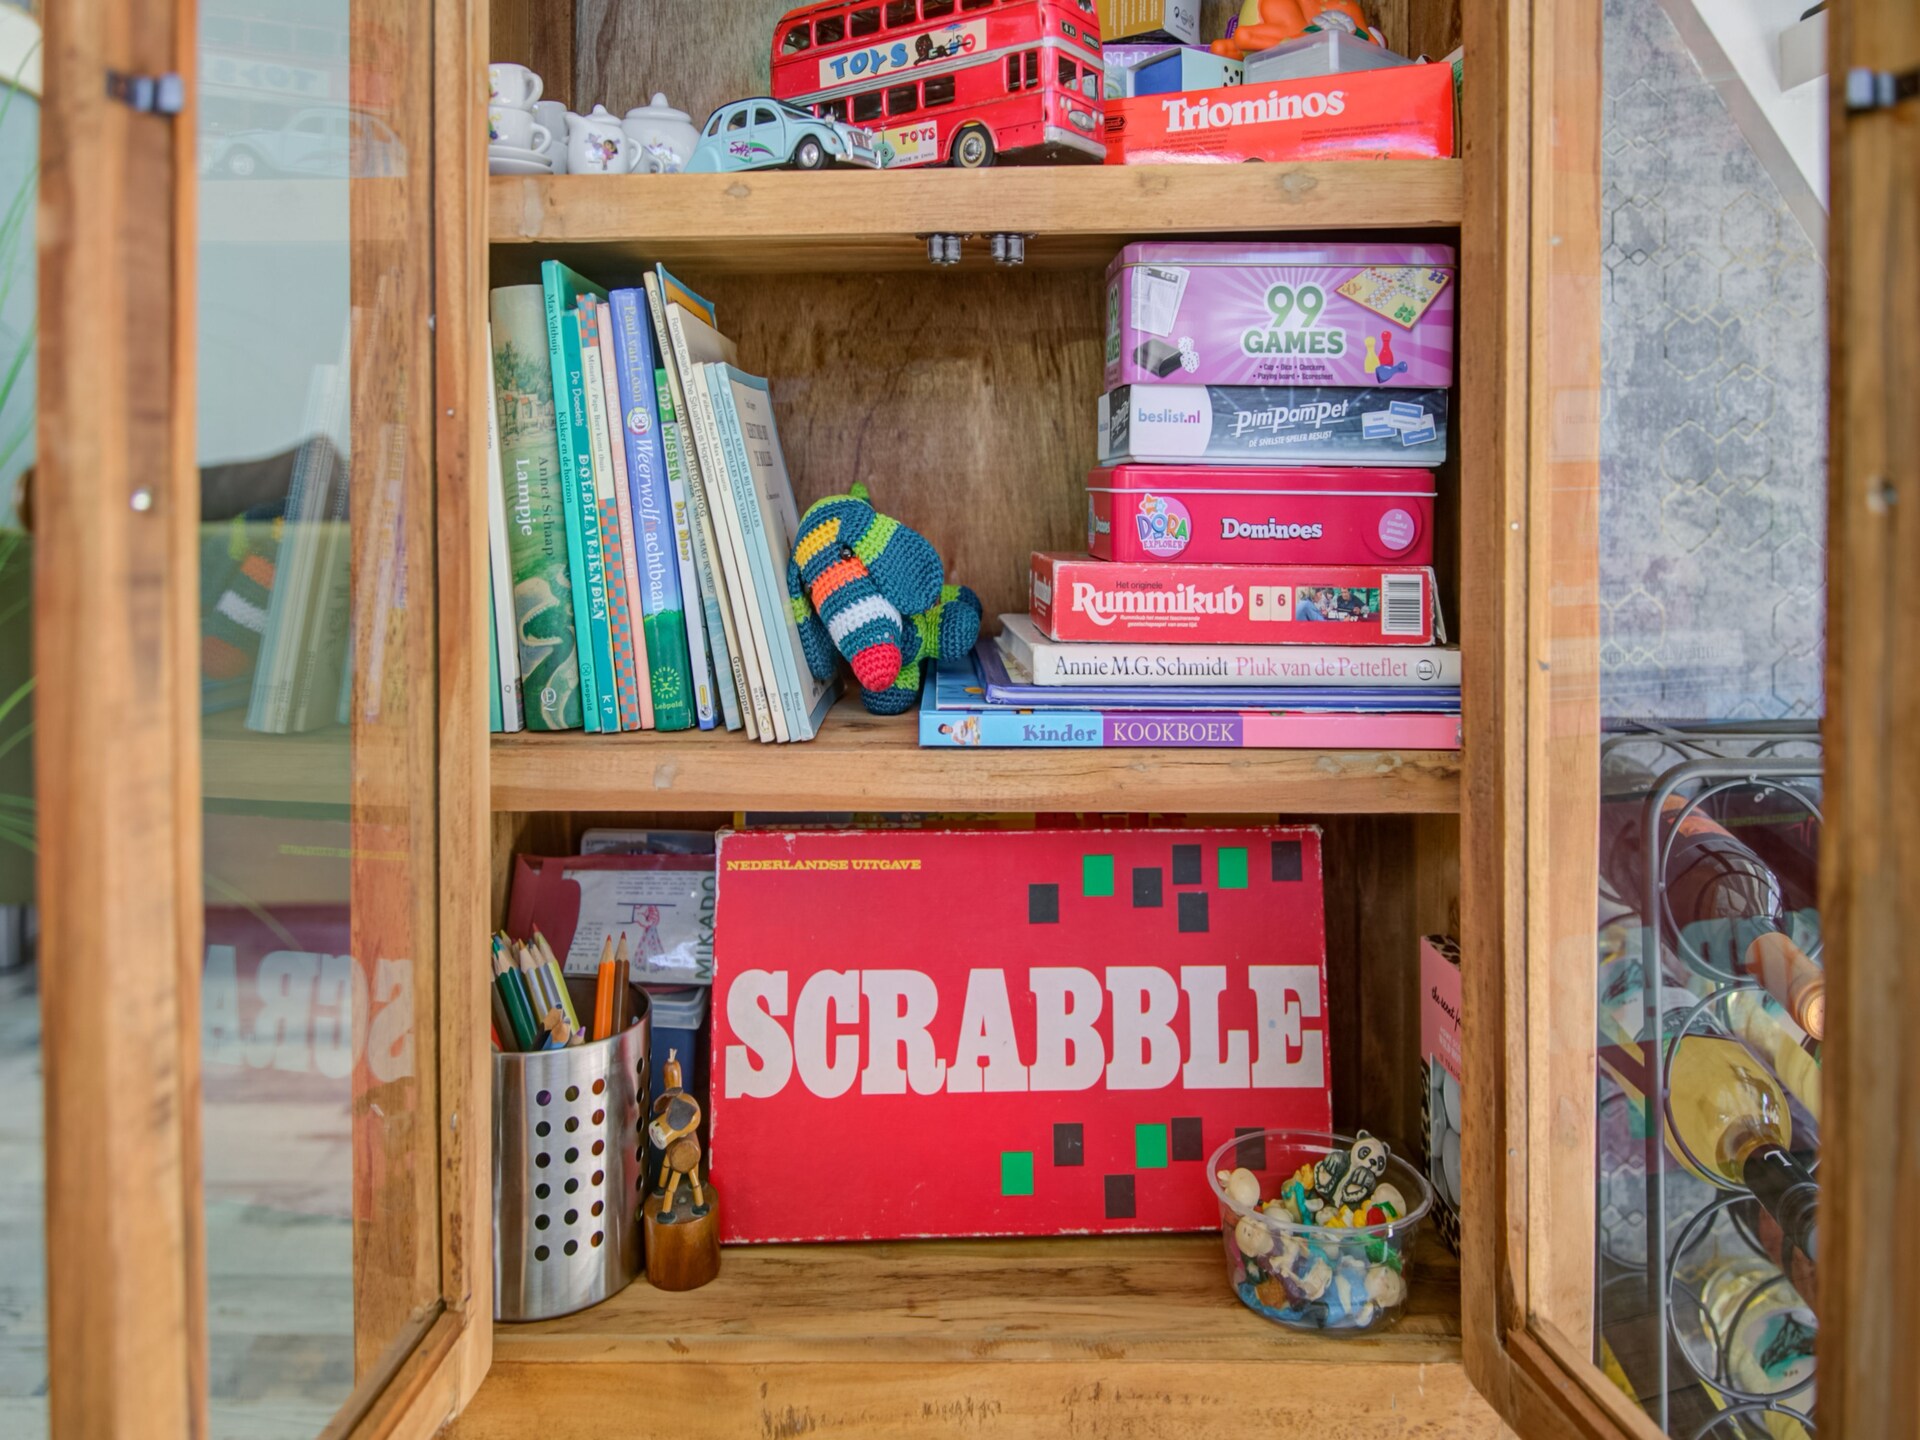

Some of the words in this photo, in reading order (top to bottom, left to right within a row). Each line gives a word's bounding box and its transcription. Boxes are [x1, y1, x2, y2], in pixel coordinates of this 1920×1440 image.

[829, 43, 908, 79] TOYS
[1162, 90, 1345, 132] Triominos
[899, 127, 935, 144] TOYS
[547, 295, 555, 313] Max
[1267, 285, 1323, 328] 99
[624, 306, 639, 335] Paul
[671, 317, 684, 348] Ronald
[549, 317, 559, 354] Velthuijs
[1244, 330, 1343, 354] GAMES
[629, 340, 641, 363] van
[676, 350, 690, 376] Searle
[571, 371, 580, 385] De
[588, 355, 597, 384] Minarik
[631, 366, 643, 402] Loon
[659, 383, 674, 410] TOP
[683, 379, 695, 394] The
[591, 394, 600, 412] Papa
[687, 396, 703, 434] Situation
[1138, 408, 1201, 424] beslist.nl
[558, 412, 567, 441] Kikker
[594, 415, 602, 431] Beer
[562, 443, 568, 454] en
[596, 433, 604, 452] komt
[663, 426, 681, 481] WISSEN
[712, 443, 720, 456] Max
[563, 456, 571, 467] de
[598, 454, 606, 472] thuis
[676, 405, 687, 432] HARE
[682, 436, 692, 457] AND
[688, 460, 707, 517] HEDGEHOG
[697, 443, 714, 483] Hopeless
[715, 458, 721, 466] en
[538, 456, 552, 500] Annet
[565, 469, 574, 503] horizon
[724, 438, 731, 448] DE
[739, 504, 751, 535] VLIEGEN
[515, 458, 535, 537] Lampje
[746, 488, 754, 497] DE
[750, 500, 760, 528] BOLLES
[620, 511, 631, 534] VAN
[675, 502, 686, 525] Das
[541, 504, 556, 556] Schaap
[1137, 513, 1188, 541] DORA
[1221, 518, 1323, 541] Dominoes
[622, 540, 633, 552] DE
[679, 530, 690, 561] Meer
[1143, 540, 1183, 549] EXPLORER
[1116, 581, 1129, 589] Het
[1131, 581, 1163, 591] originele
[1072, 582, 1244, 626] Rummikub
[1255, 594, 1263, 606] 5
[1278, 594, 1286, 606] 6
[1055, 656, 1108, 676] Annie
[1156, 656, 1228, 677] Schmidt
[1236, 657, 1278, 677] Pluk
[1281, 663, 1311, 677] van
[1314, 657, 1335, 677] de
[1338, 657, 1408, 678] Petteflet
[584, 679, 592, 711] Leopold
[732, 656, 751, 715] Grasshopper
[1023, 723, 1098, 743] Kinder
[1112, 722, 1235, 743] KOOKBOEK
[726, 860, 849, 871] NEDERLANDSE
[851, 859, 922, 871] UITGAVE
[724, 965, 1325, 1099] SCRABBLE
